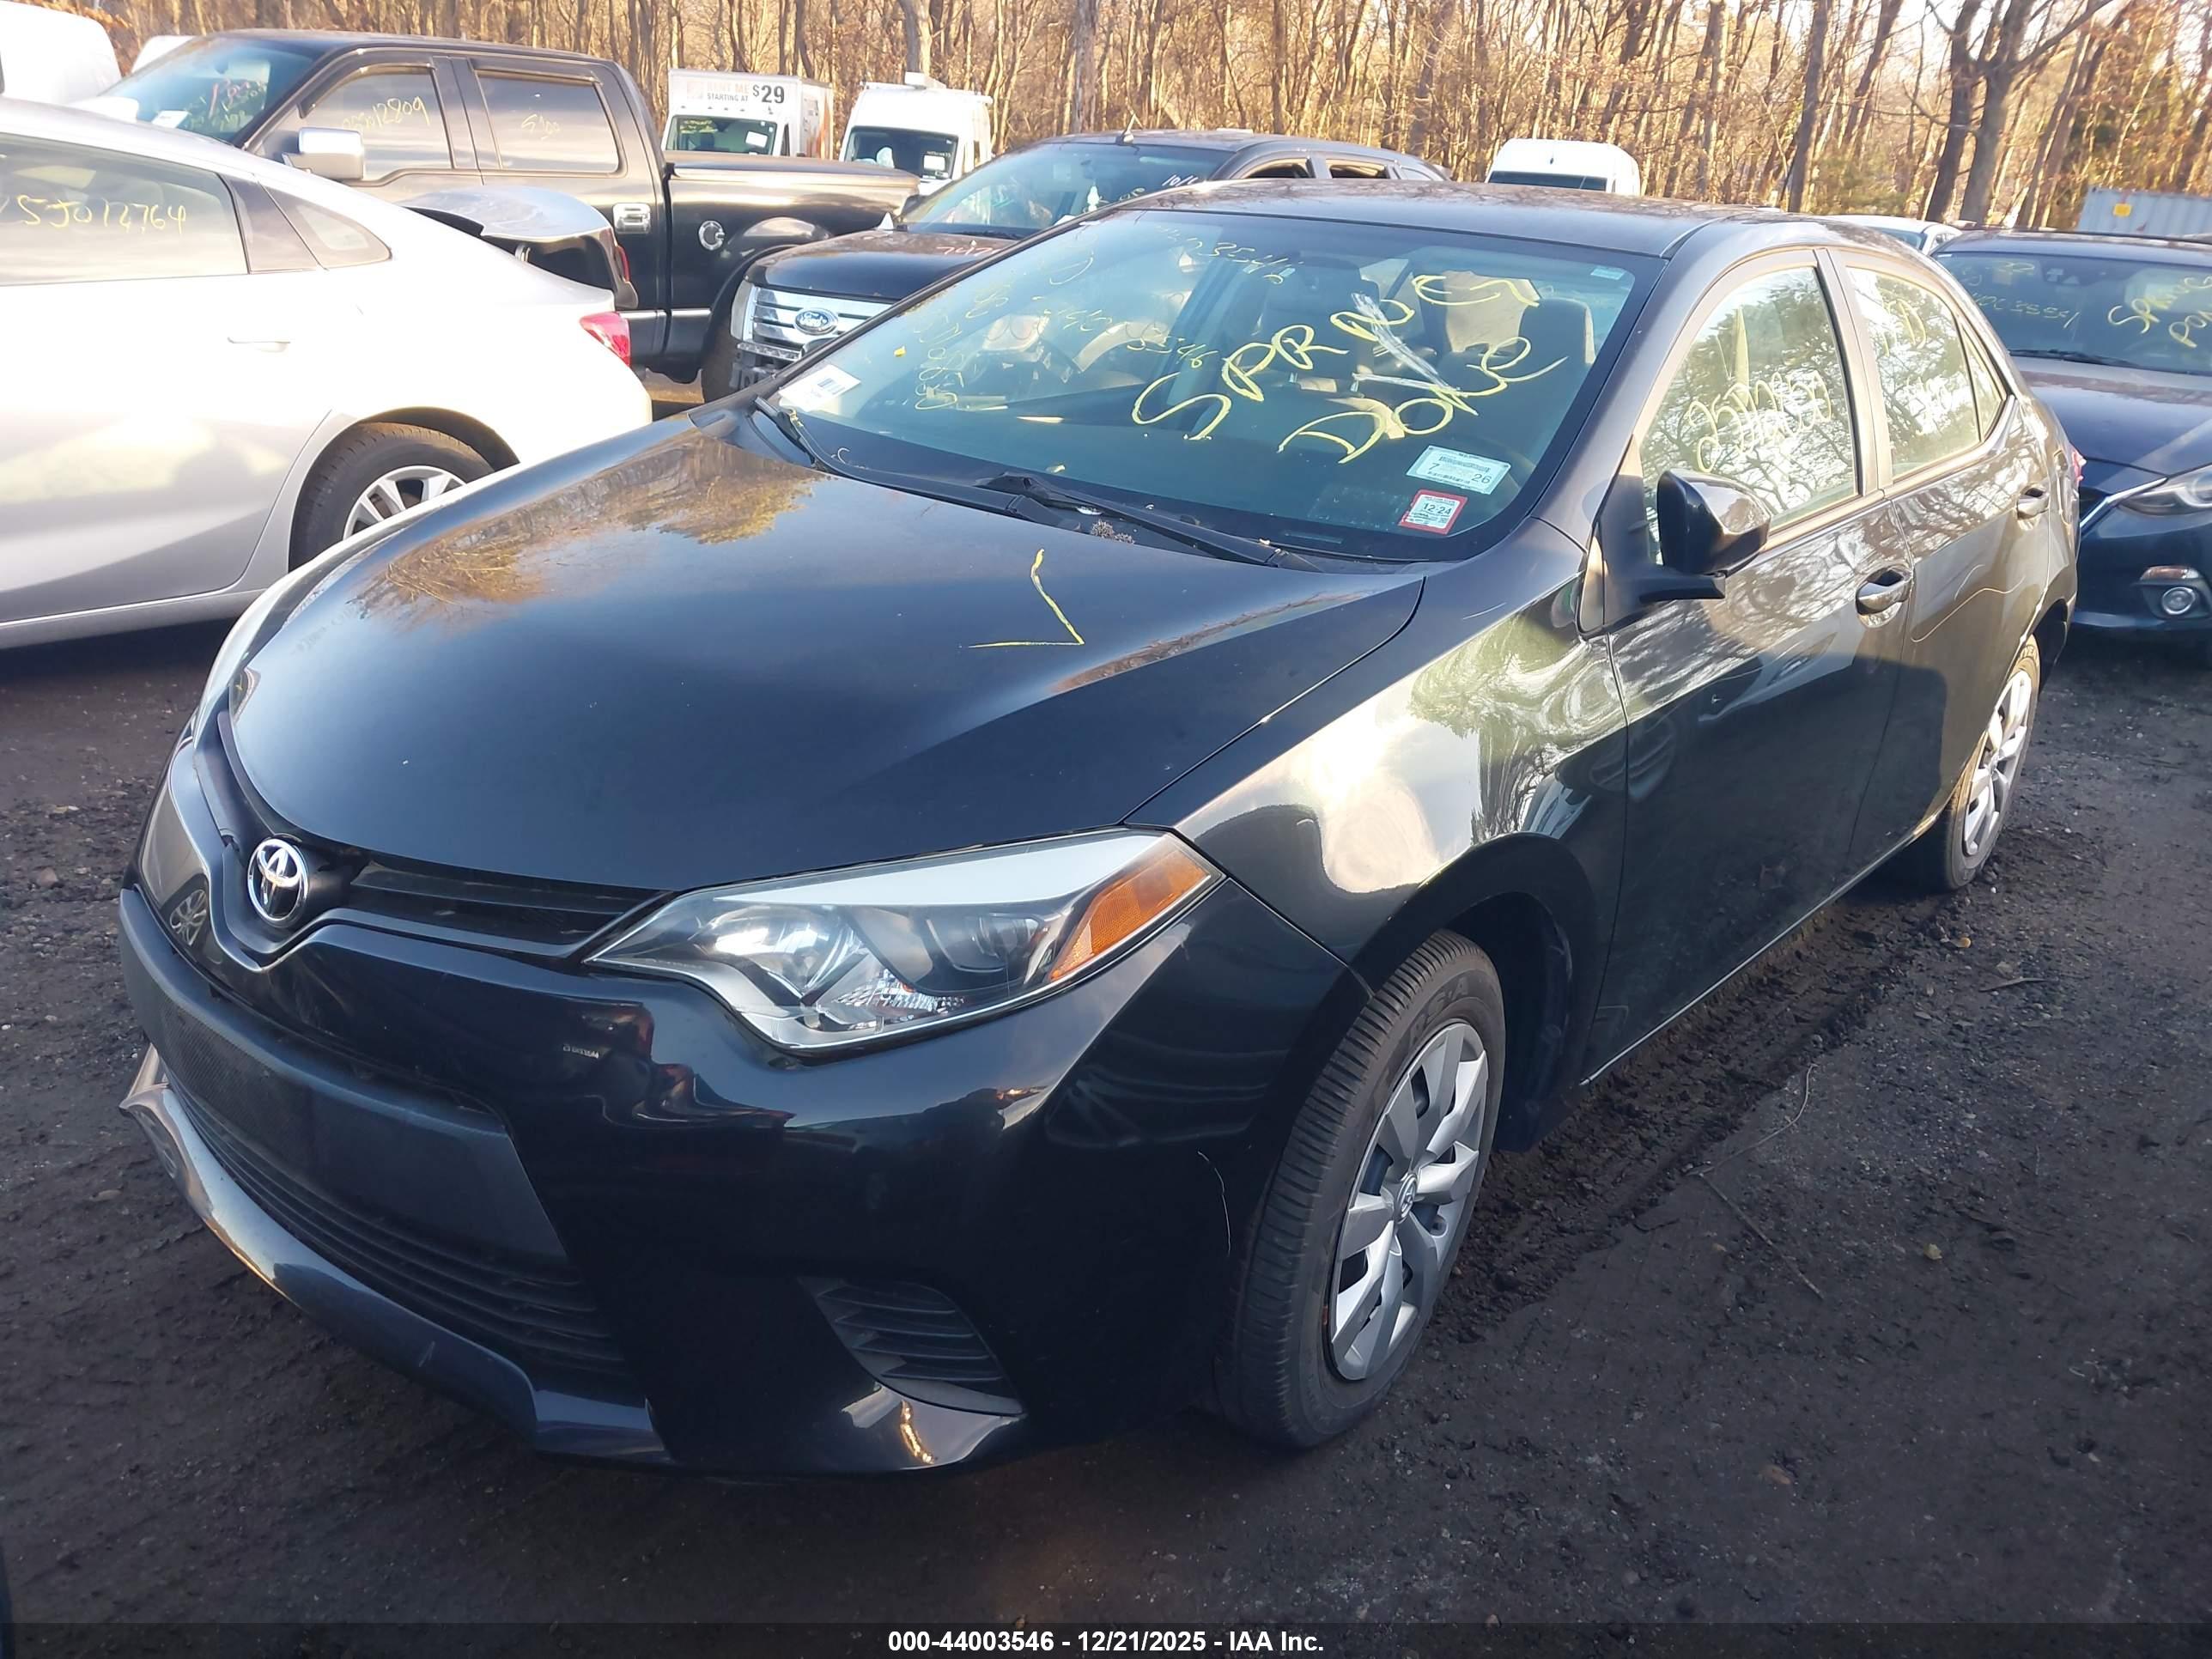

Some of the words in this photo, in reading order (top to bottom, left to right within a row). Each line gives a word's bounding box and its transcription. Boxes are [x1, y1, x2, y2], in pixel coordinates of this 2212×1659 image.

[707, 92, 739, 102] STARTING
[752, 83, 785, 104] $29
[1471, 473, 1492, 484] 26
